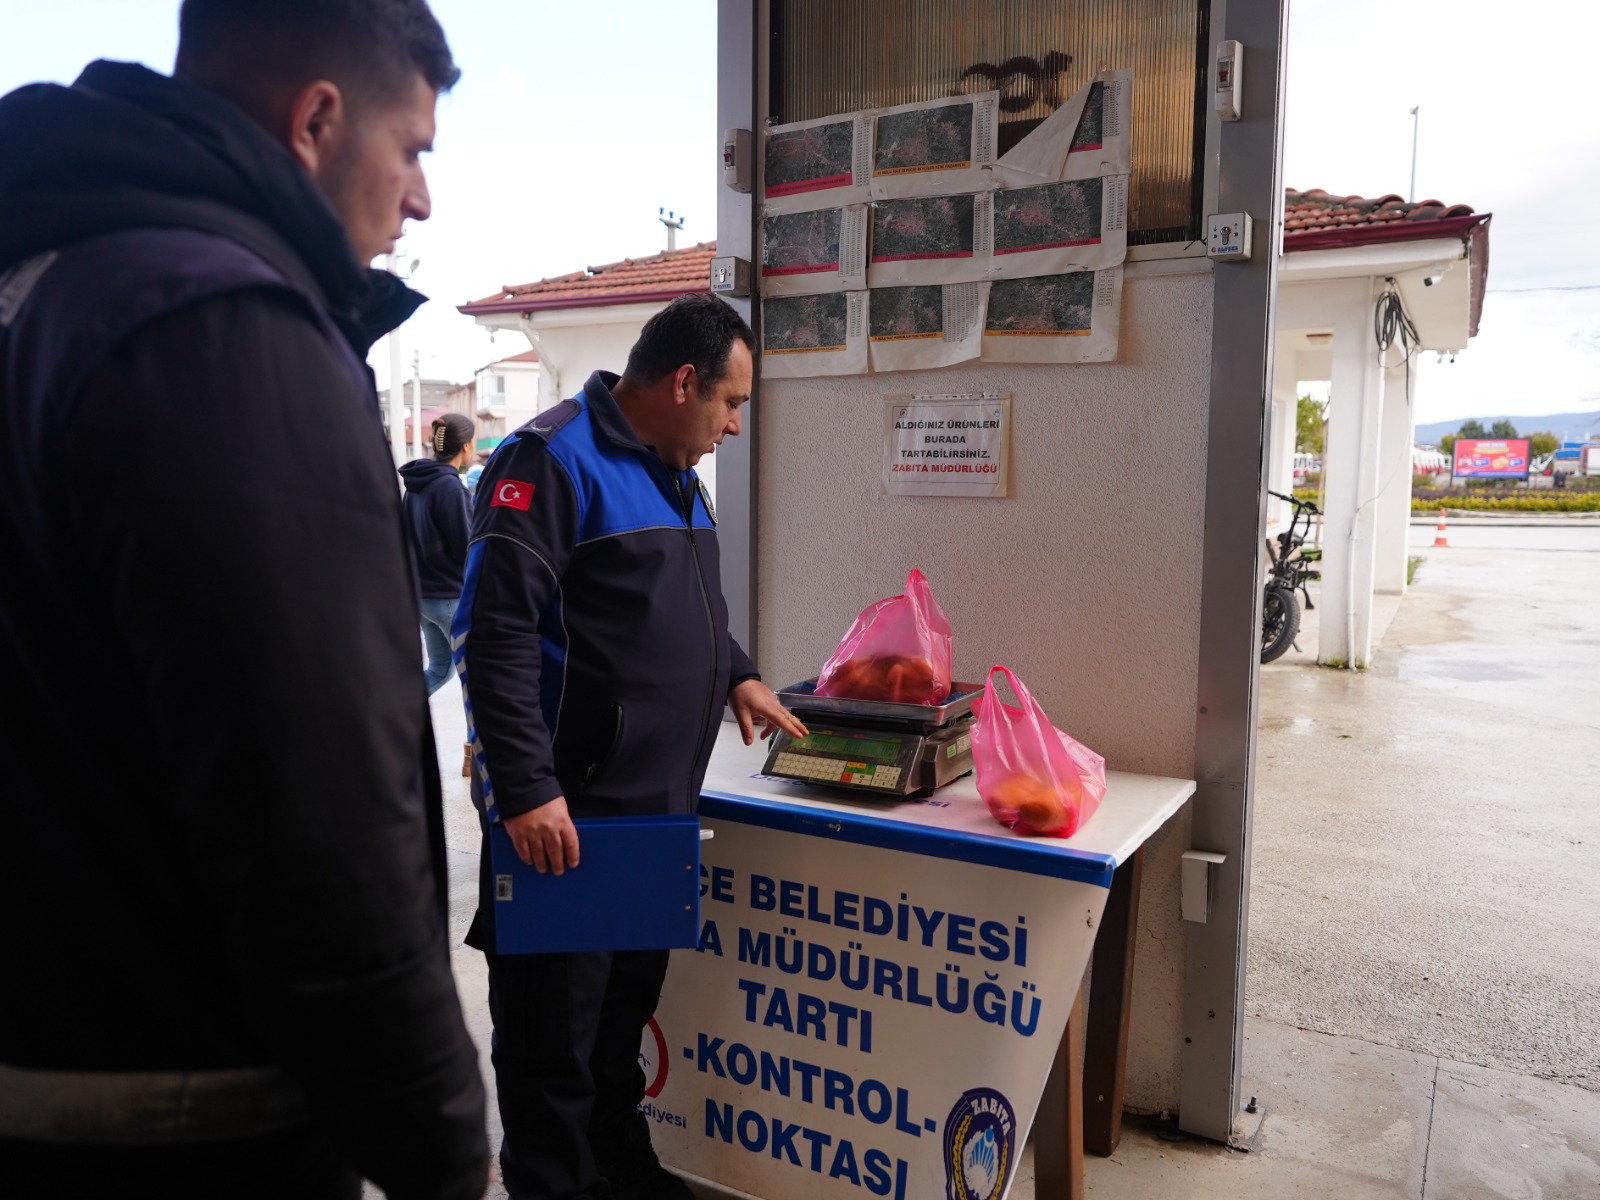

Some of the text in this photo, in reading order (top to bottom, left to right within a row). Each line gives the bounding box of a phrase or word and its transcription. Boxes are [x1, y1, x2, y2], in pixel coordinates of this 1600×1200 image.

[895, 419, 999, 429] ALDIĞINIZ ÜRÜNLERİ
[901, 448, 990, 459] TARTABİLİRSİNİZ.
[892, 463, 997, 473] ZABITA MÜDÜRLÜĞÜ
[751, 874, 1027, 967] BELEDİYESİ
[738, 927, 1042, 1037] MÜDÜRLÜĞÜ
[738, 978, 872, 1053] TARTI
[683, 1032, 936, 1138] -KONTROL-
[970, 1096, 1012, 1137] ZABITA
[705, 1098, 908, 1200] NOKTASI
